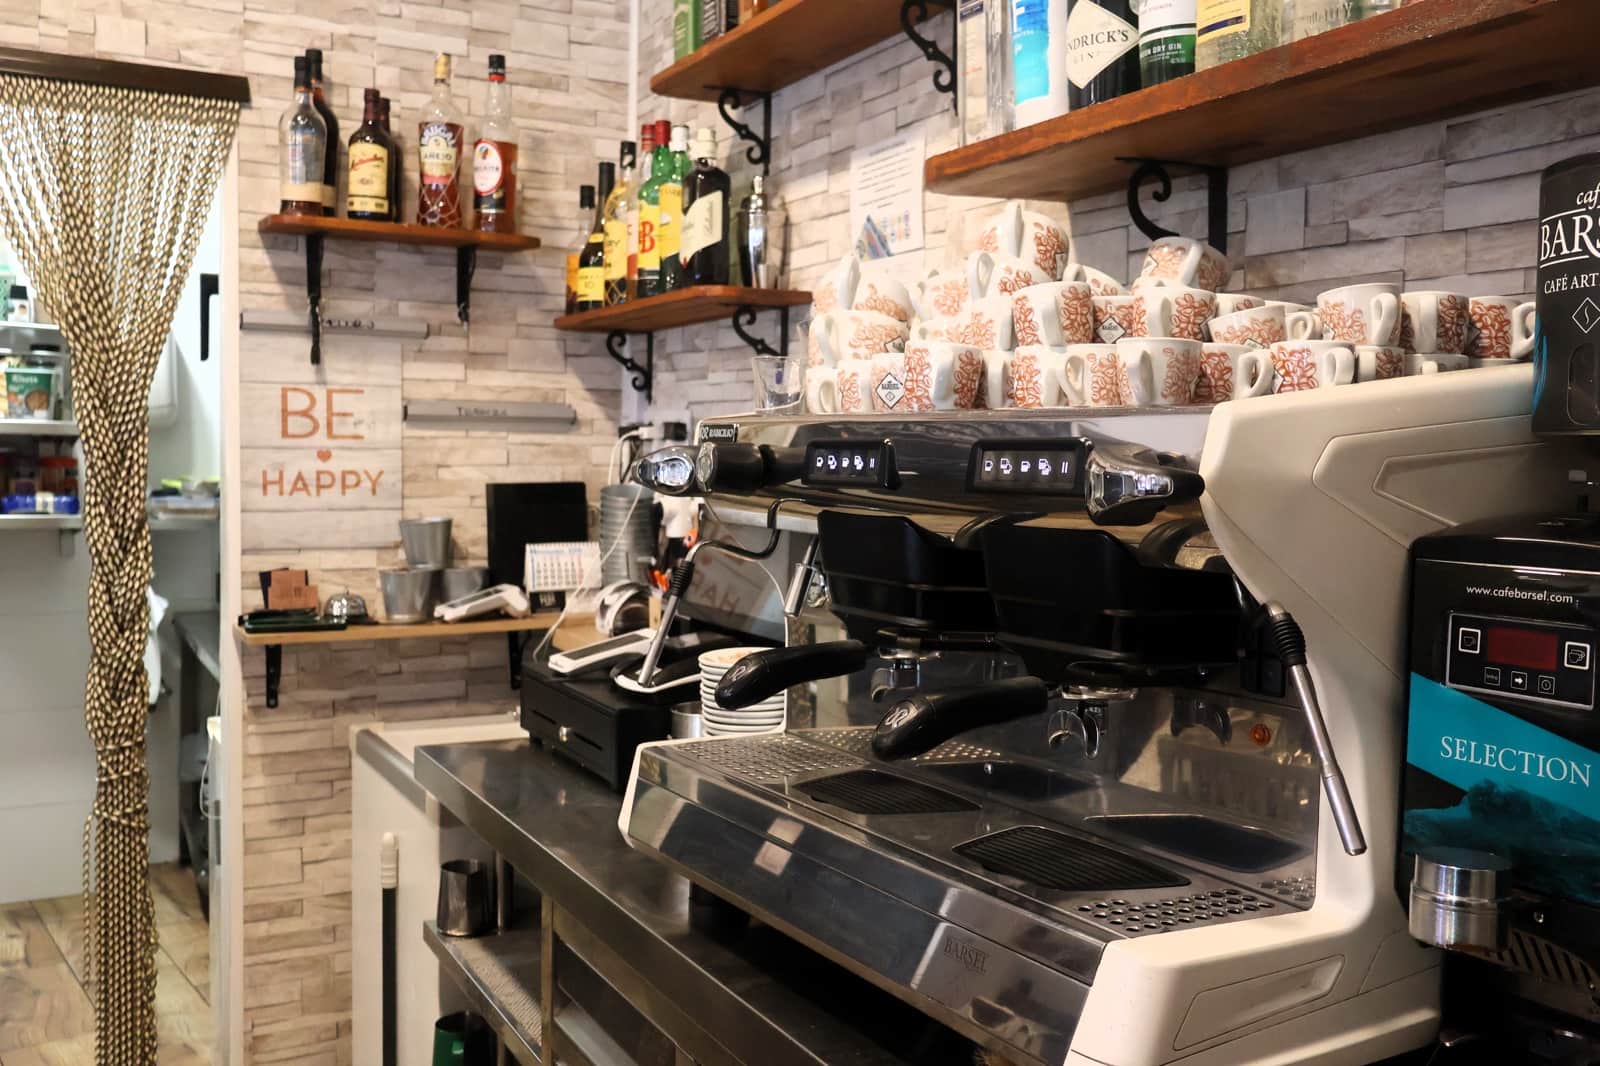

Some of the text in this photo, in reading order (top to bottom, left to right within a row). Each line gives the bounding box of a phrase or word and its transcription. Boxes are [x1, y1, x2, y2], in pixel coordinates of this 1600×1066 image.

[1168, 42, 1182, 51] GIN
[1541, 214, 1600, 261] BAR
[1544, 273, 1568, 294] CAFÉ
[281, 386, 365, 440] BE
[262, 469, 384, 497] HAPPY
[1466, 584, 1573, 605] www.cafebarsel.com
[1440, 735, 1592, 788] SELECTION
[943, 938, 988, 973] BARSEL
